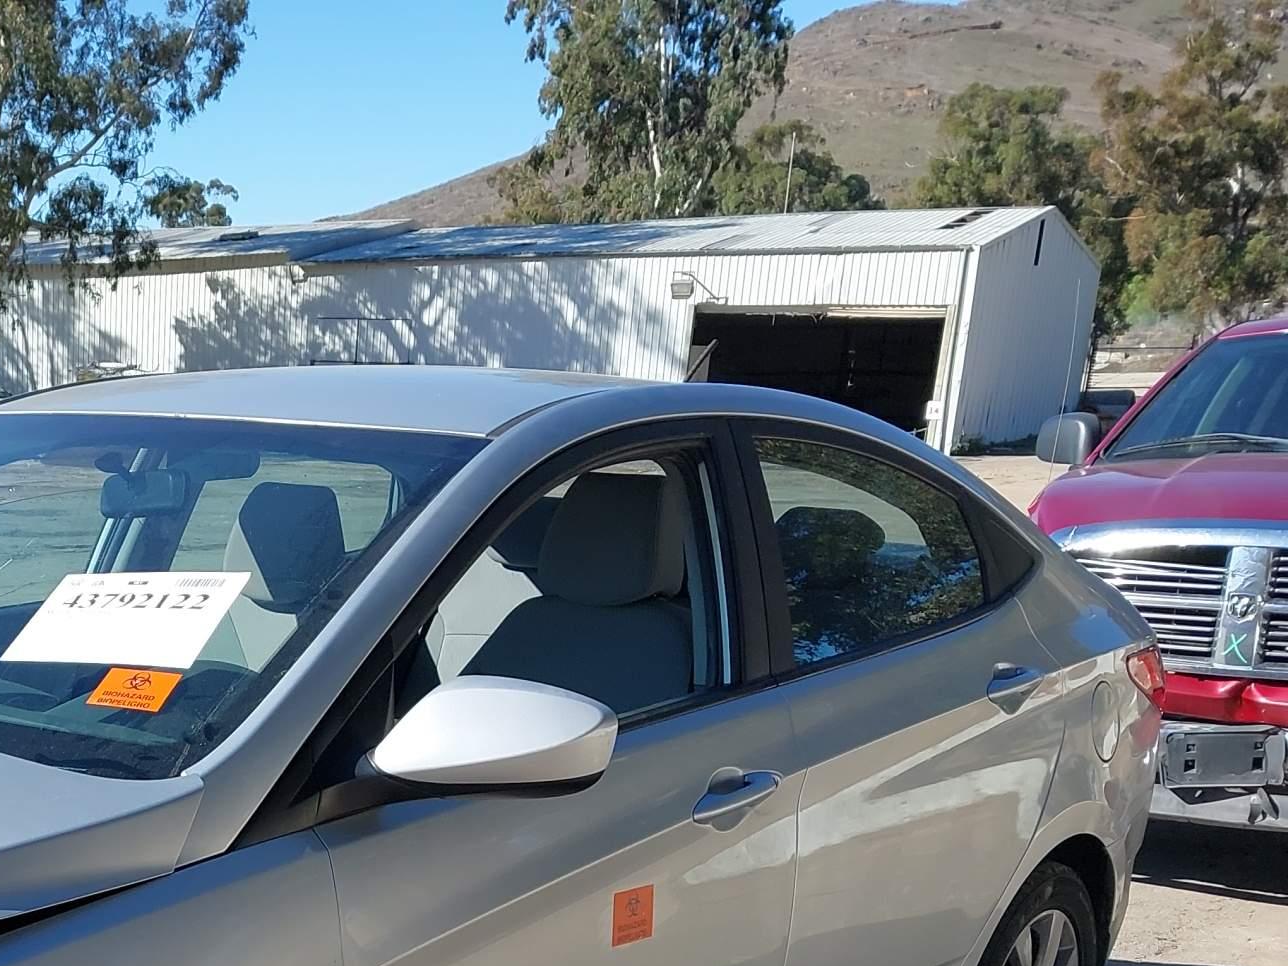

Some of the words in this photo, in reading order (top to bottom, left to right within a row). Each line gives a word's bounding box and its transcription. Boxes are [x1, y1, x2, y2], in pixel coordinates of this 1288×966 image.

[63, 593, 210, 609] 43792122
[102, 690, 156, 701] BIOHAZARD
[96, 697, 152, 709] BIOPELIGRO
